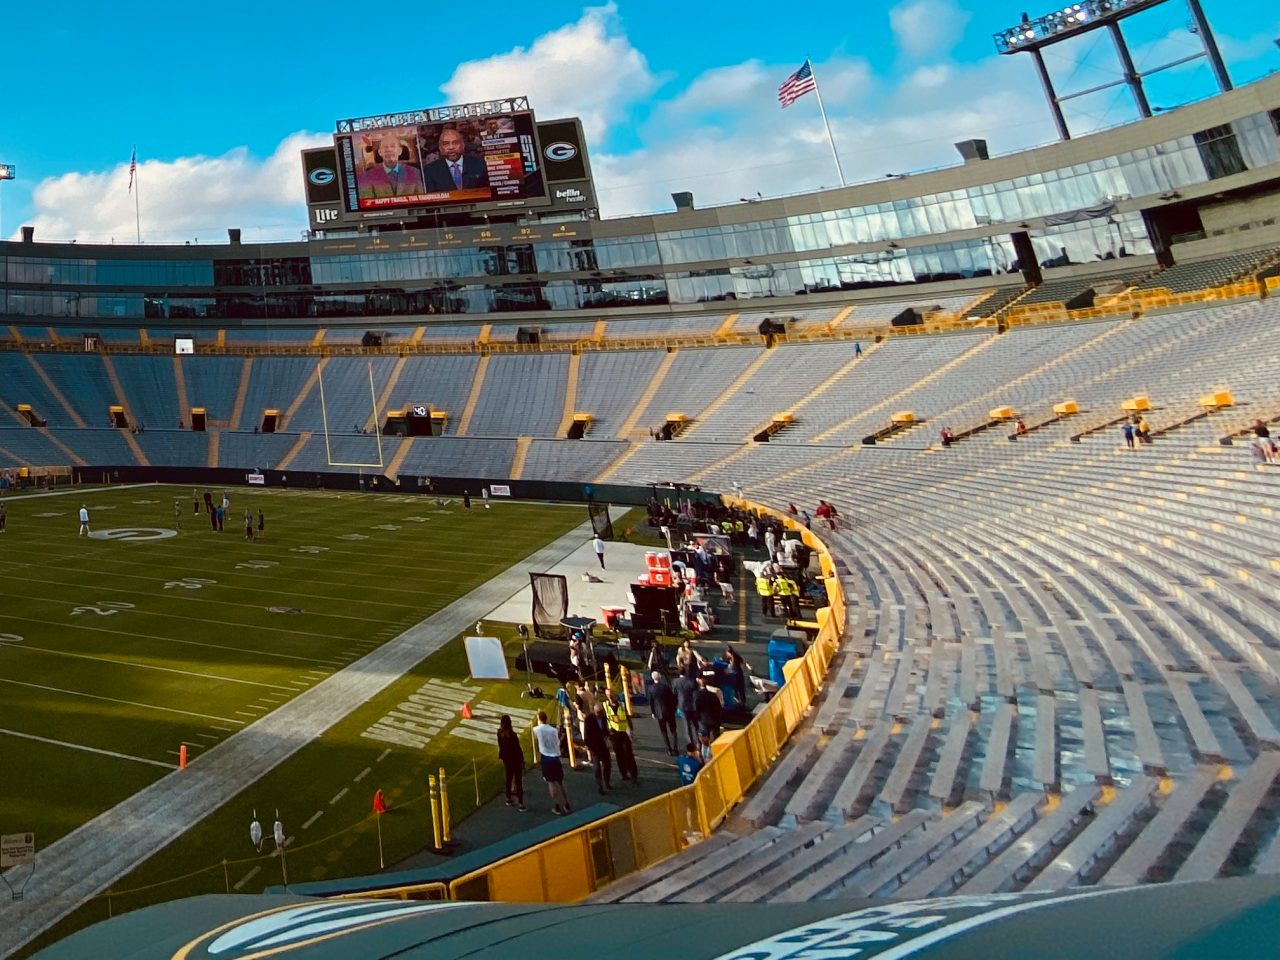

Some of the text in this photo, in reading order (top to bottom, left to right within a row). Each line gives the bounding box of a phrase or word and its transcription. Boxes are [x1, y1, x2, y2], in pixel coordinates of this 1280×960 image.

[359, 101, 502, 129] LAMBEAU FIELD
[342, 138, 354, 172] COUNTDOWN
[520, 134, 537, 171] ESPN
[345, 171, 356, 188] NIGHT
[556, 188, 580, 198] bellin
[315, 208, 338, 224] Lite
[414, 406, 426, 416] 40
[164, 577, 217, 590] 30
[70, 600, 136, 616] 20
[360, 677, 483, 749] WELCOME
